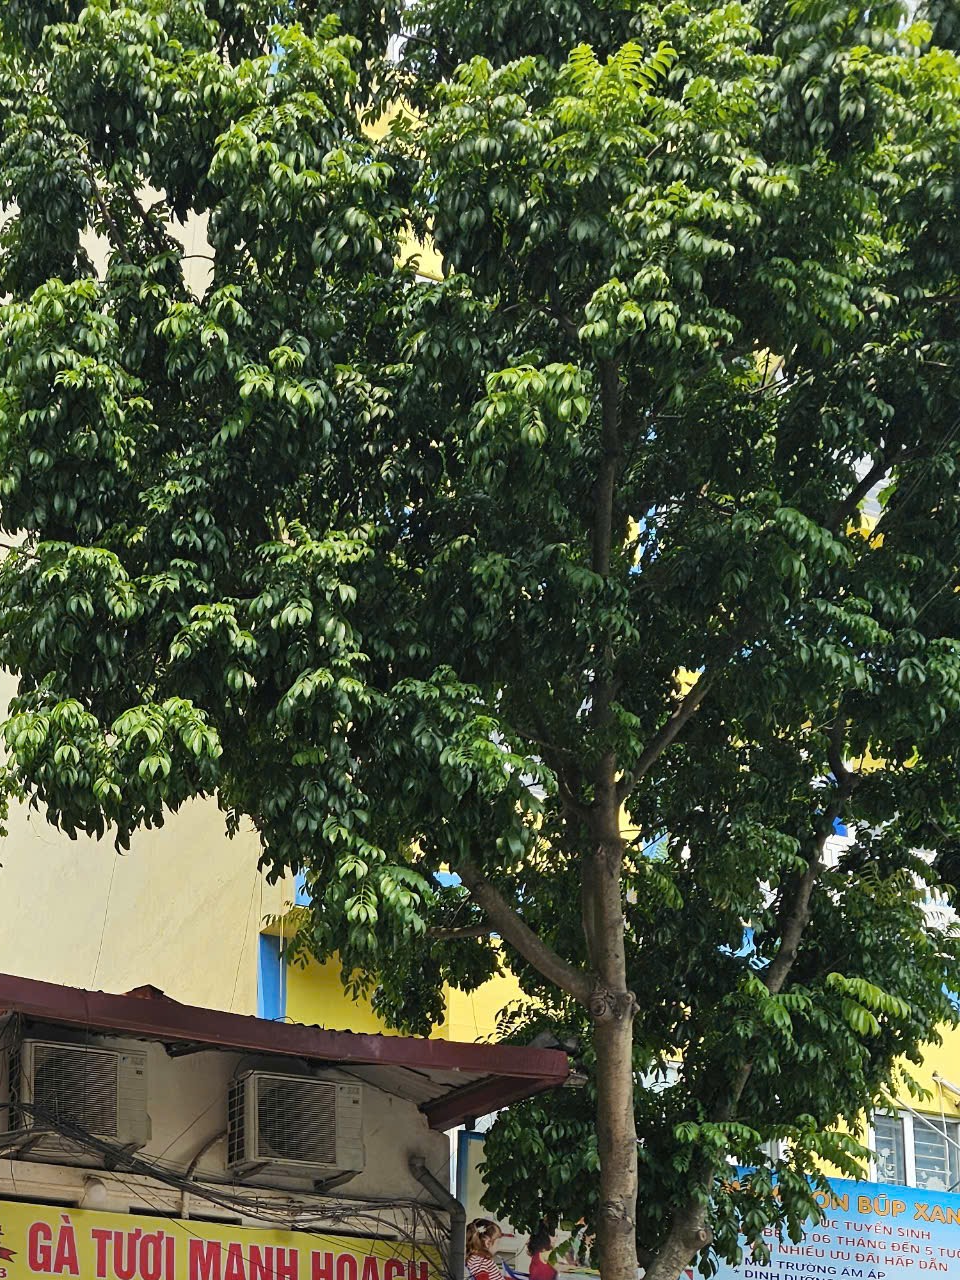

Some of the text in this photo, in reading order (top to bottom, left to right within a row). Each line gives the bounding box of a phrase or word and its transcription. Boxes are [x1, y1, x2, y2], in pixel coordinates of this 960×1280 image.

[858, 1194, 906, 1217] BÚP
[844, 1220, 892, 1235] TUYỂN
[897, 1227, 931, 1240] SINH
[28, 1214, 79, 1276] GÀ
[813, 1233, 831, 1244] 06
[837, 1235, 887, 1250] THÁNG
[891, 1241, 920, 1254] ĐẾN
[925, 1246, 933, 1256] 5
[830, 1250, 850, 1261] ƯU
[855, 1252, 879, 1264] ĐÃI
[885, 1254, 914, 1267] HẤP
[776, 1260, 837, 1275] TRƯỜNG
[868, 1268, 886, 1280] ÁP
